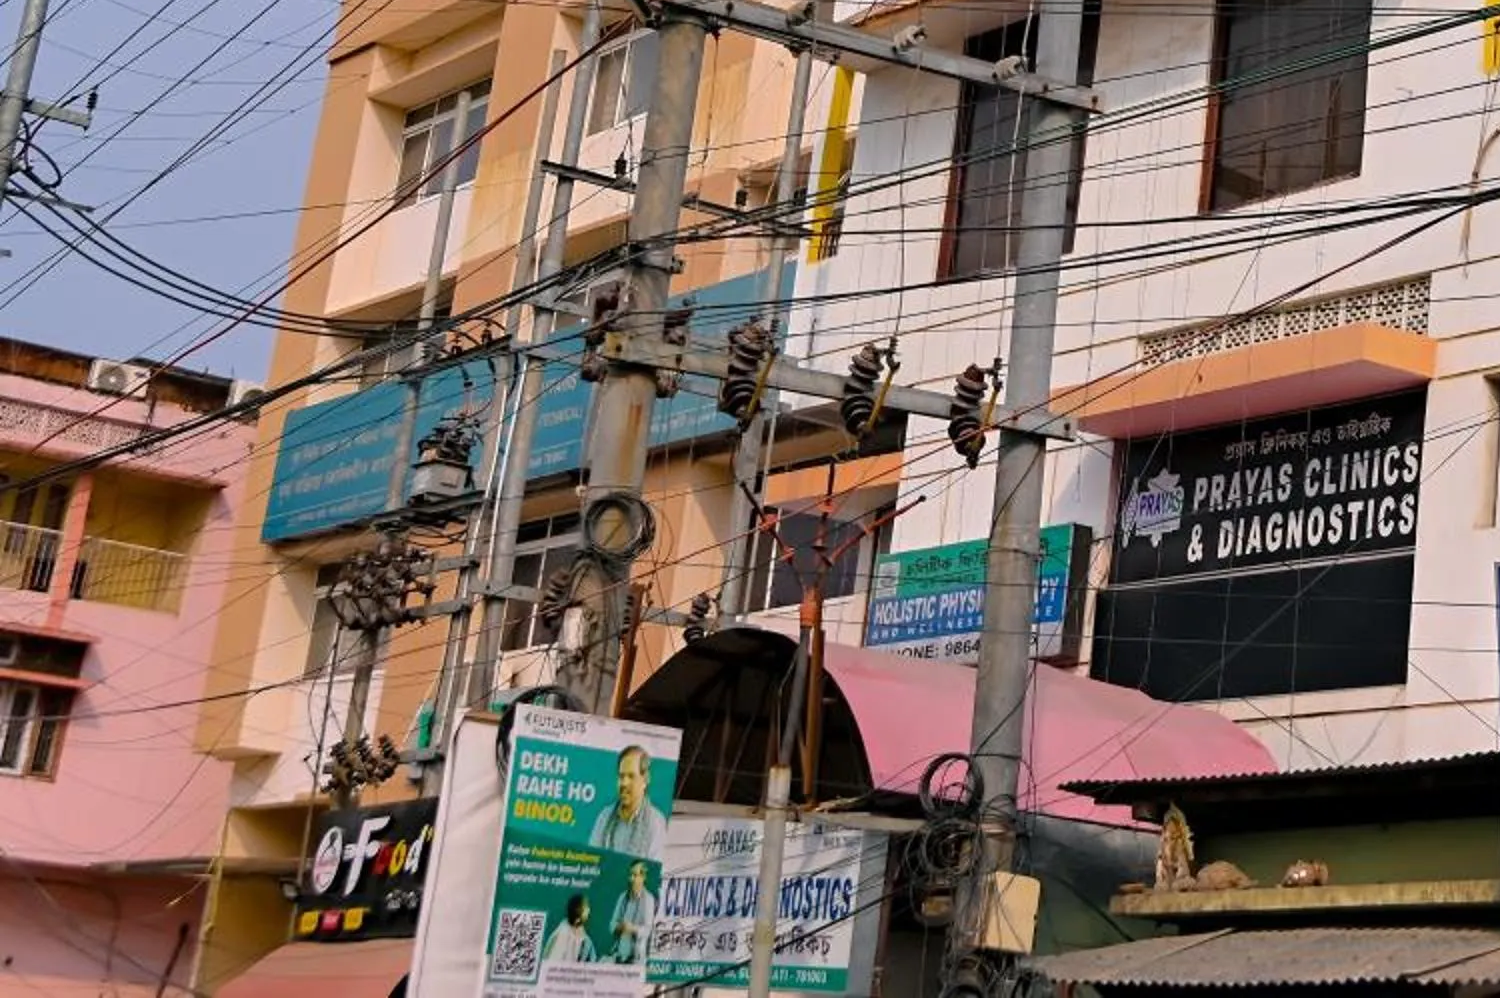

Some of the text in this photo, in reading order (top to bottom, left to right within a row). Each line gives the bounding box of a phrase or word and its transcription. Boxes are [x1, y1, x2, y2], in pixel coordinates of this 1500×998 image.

[1193, 442, 1420, 514] PRAYAS CLINICS
[1139, 487, 1184, 517] PRAYAS
[1186, 493, 1416, 563] & DIAGNOSTICS
[873, 595, 936, 625] HOLISTIC
[520, 750, 569, 775] DEKH
[516, 774, 597, 804] RAHE HO
[513, 799, 577, 826] BINOD,
[713, 830, 757, 859] PRAYAS
[665, 876, 725, 919] CLINICS
[726, 876, 738, 919] &
